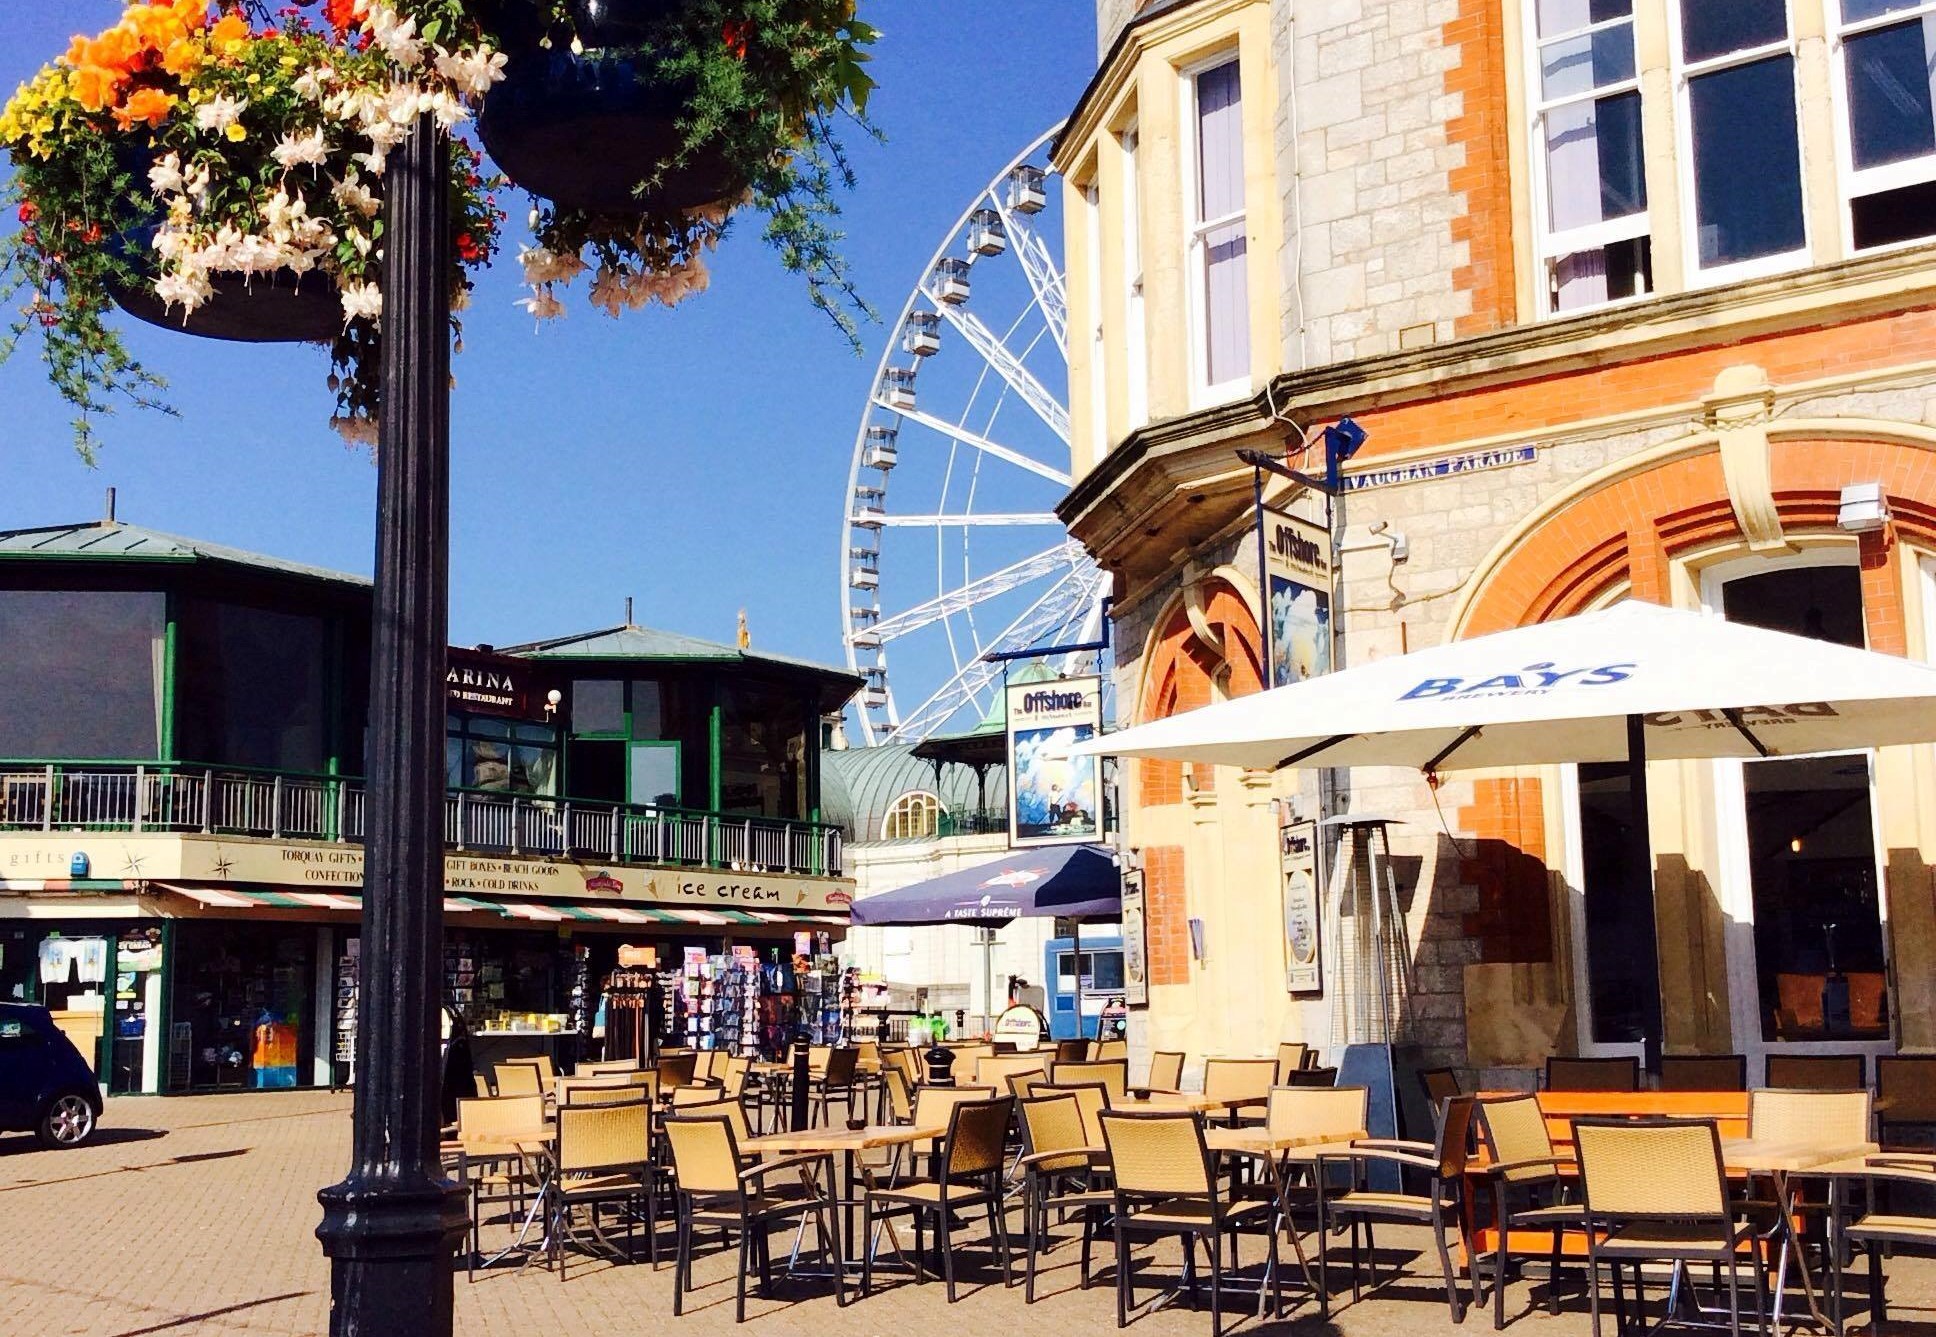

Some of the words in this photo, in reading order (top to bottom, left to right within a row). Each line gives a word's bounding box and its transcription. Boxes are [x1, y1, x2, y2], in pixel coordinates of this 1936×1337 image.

[1349, 465, 1438, 490] VAUGHAN
[1448, 448, 1526, 474] PARADE
[1275, 523, 1320, 569] Offshore
[446, 666, 514, 692] ARINA
[1395, 661, 1638, 702] BAYS
[462, 691, 514, 706] RESTAURANT
[1023, 690, 1082, 714] Offshore
[1440, 689, 1552, 702] BREWERY
[10, 850, 65, 867] gifts
[281, 849, 323, 864] TORQUAY
[328, 853, 357, 864] GIFTS
[446, 860, 466, 871] GIFT
[469, 861, 497, 872] BOXES
[503, 863, 529, 874] BEACH
[531, 865, 560, 876] GOODS
[451, 877, 475, 888] ROCK
[482, 879, 505, 890] COLD
[508, 879, 540, 891] DRINKS
[676, 874, 706, 897] ice
[717, 884, 781, 901] cream
[944, 910, 952, 919] A
[954, 908, 978, 918] TASTE
[980, 906, 1023, 918] SUPRÊME
